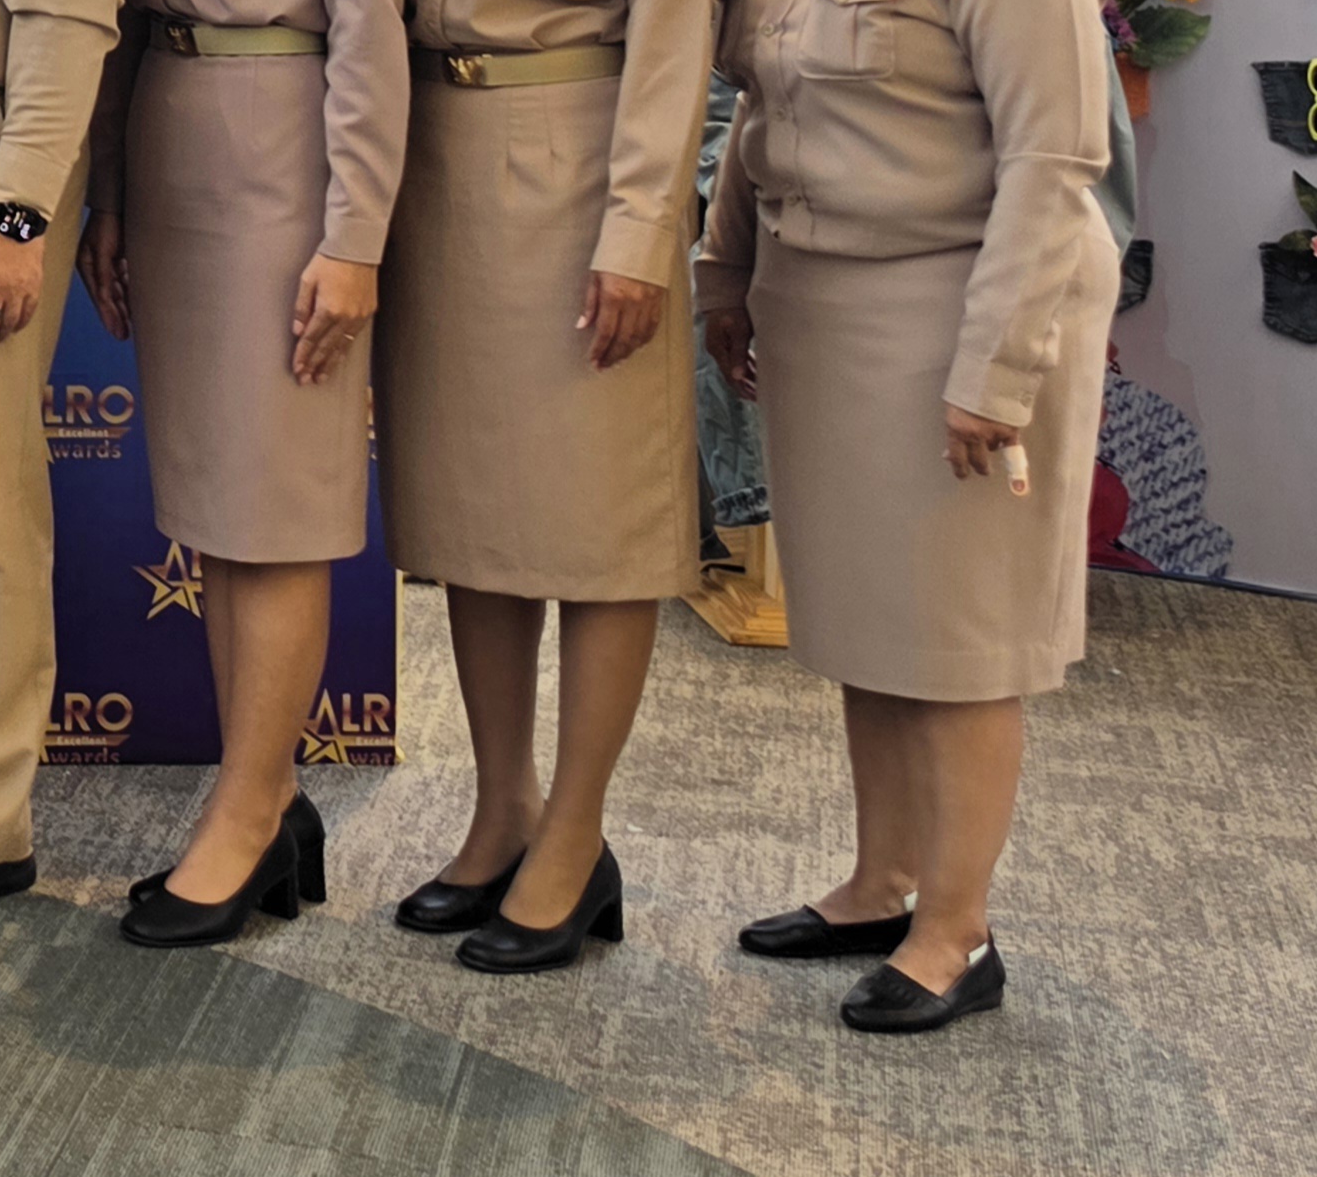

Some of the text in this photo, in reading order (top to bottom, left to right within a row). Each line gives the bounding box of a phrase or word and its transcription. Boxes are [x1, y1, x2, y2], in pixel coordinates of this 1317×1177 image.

[44, 385, 134, 425] LRO
[59, 427, 109, 438] Excellent
[303, 689, 391, 744] ALR
[57, 735, 107, 745] Excellent
[350, 750, 393, 765] war
